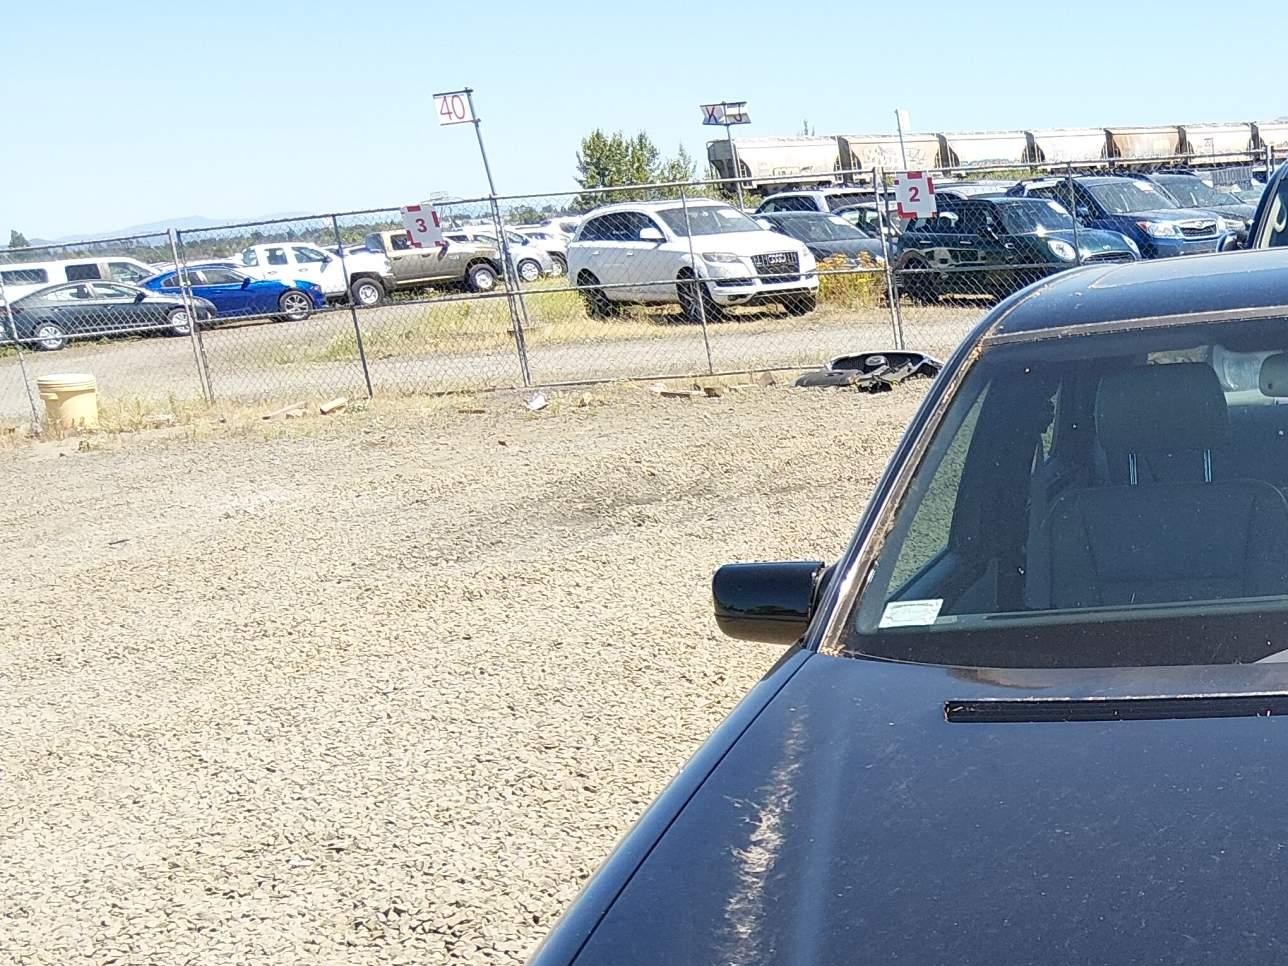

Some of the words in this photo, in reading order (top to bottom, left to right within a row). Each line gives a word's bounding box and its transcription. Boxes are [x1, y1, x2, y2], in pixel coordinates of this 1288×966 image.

[440, 95, 466, 121] 40
[908, 186, 921, 202] 2
[415, 218, 428, 233] 3
